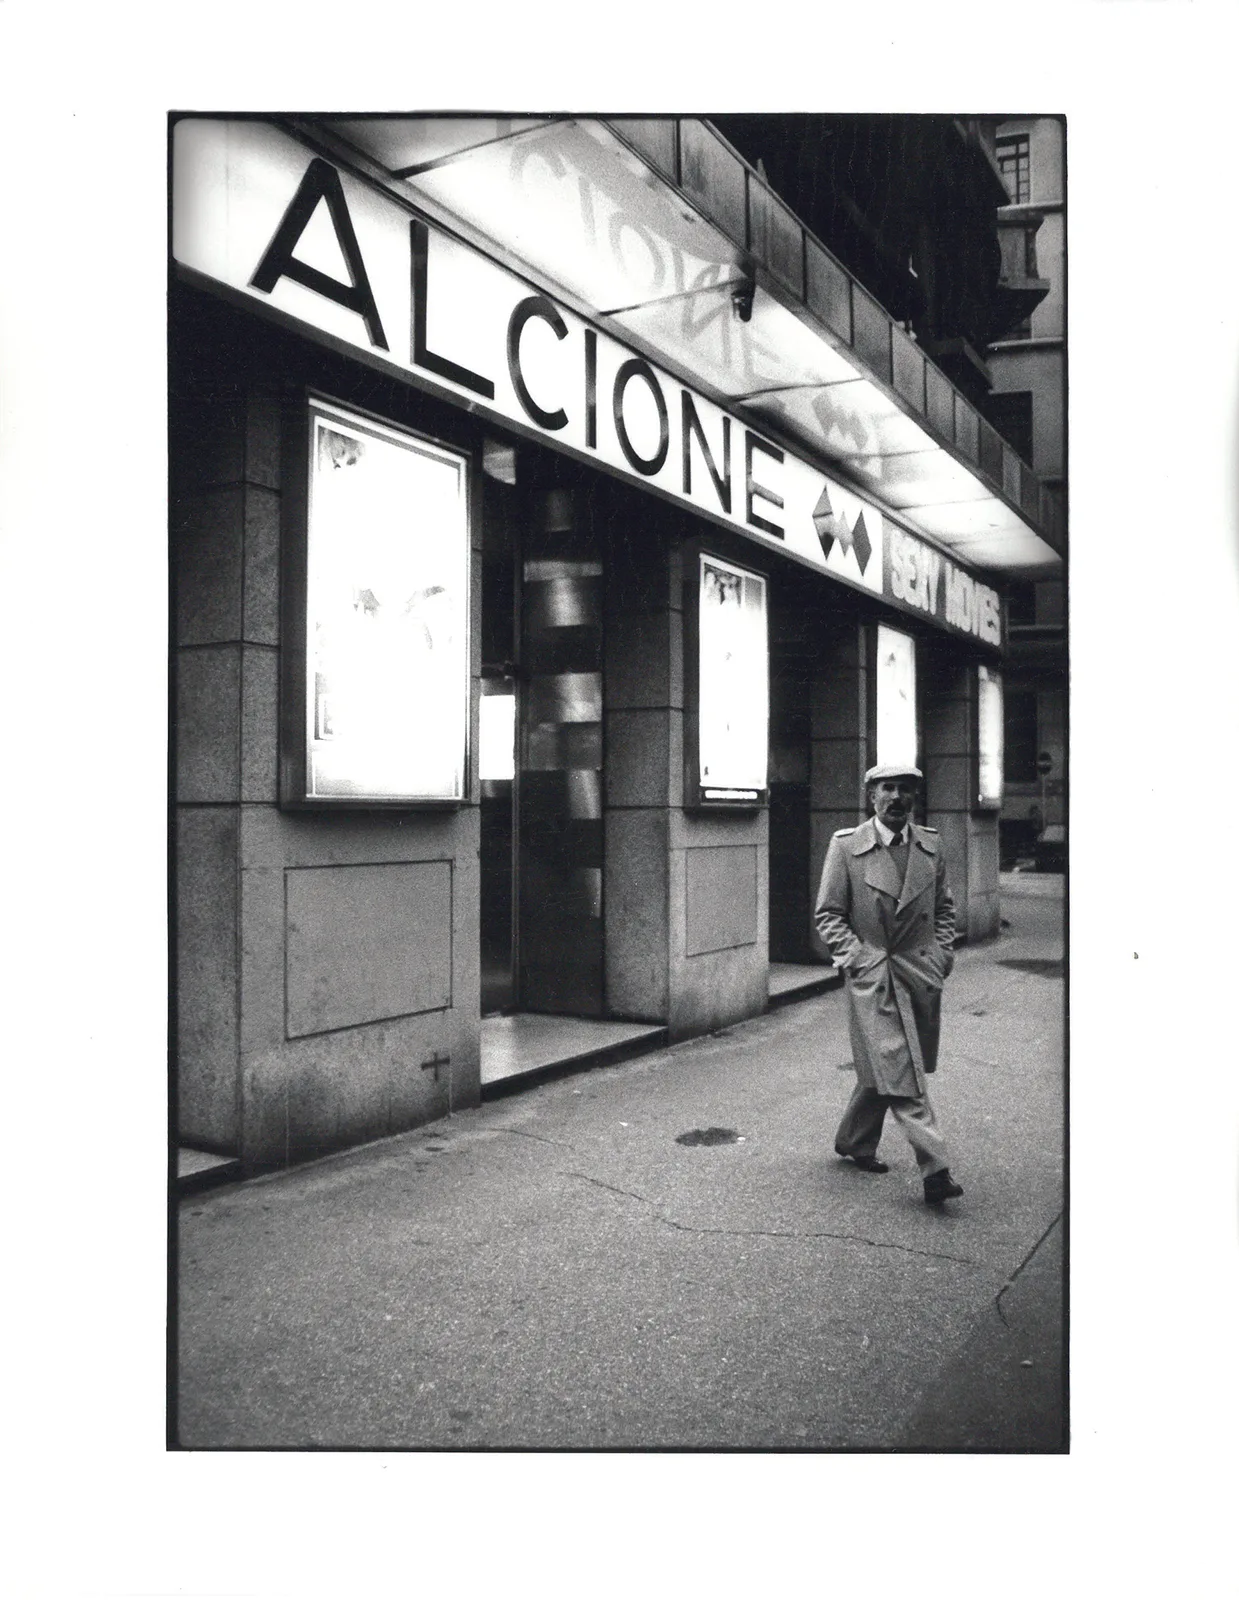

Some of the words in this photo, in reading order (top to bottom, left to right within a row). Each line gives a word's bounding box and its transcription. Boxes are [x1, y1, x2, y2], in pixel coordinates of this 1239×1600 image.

[247, 158, 785, 540] ALCIONE
[890, 529, 940, 615] SEXY
[945, 562, 1001, 646] MOVIES
